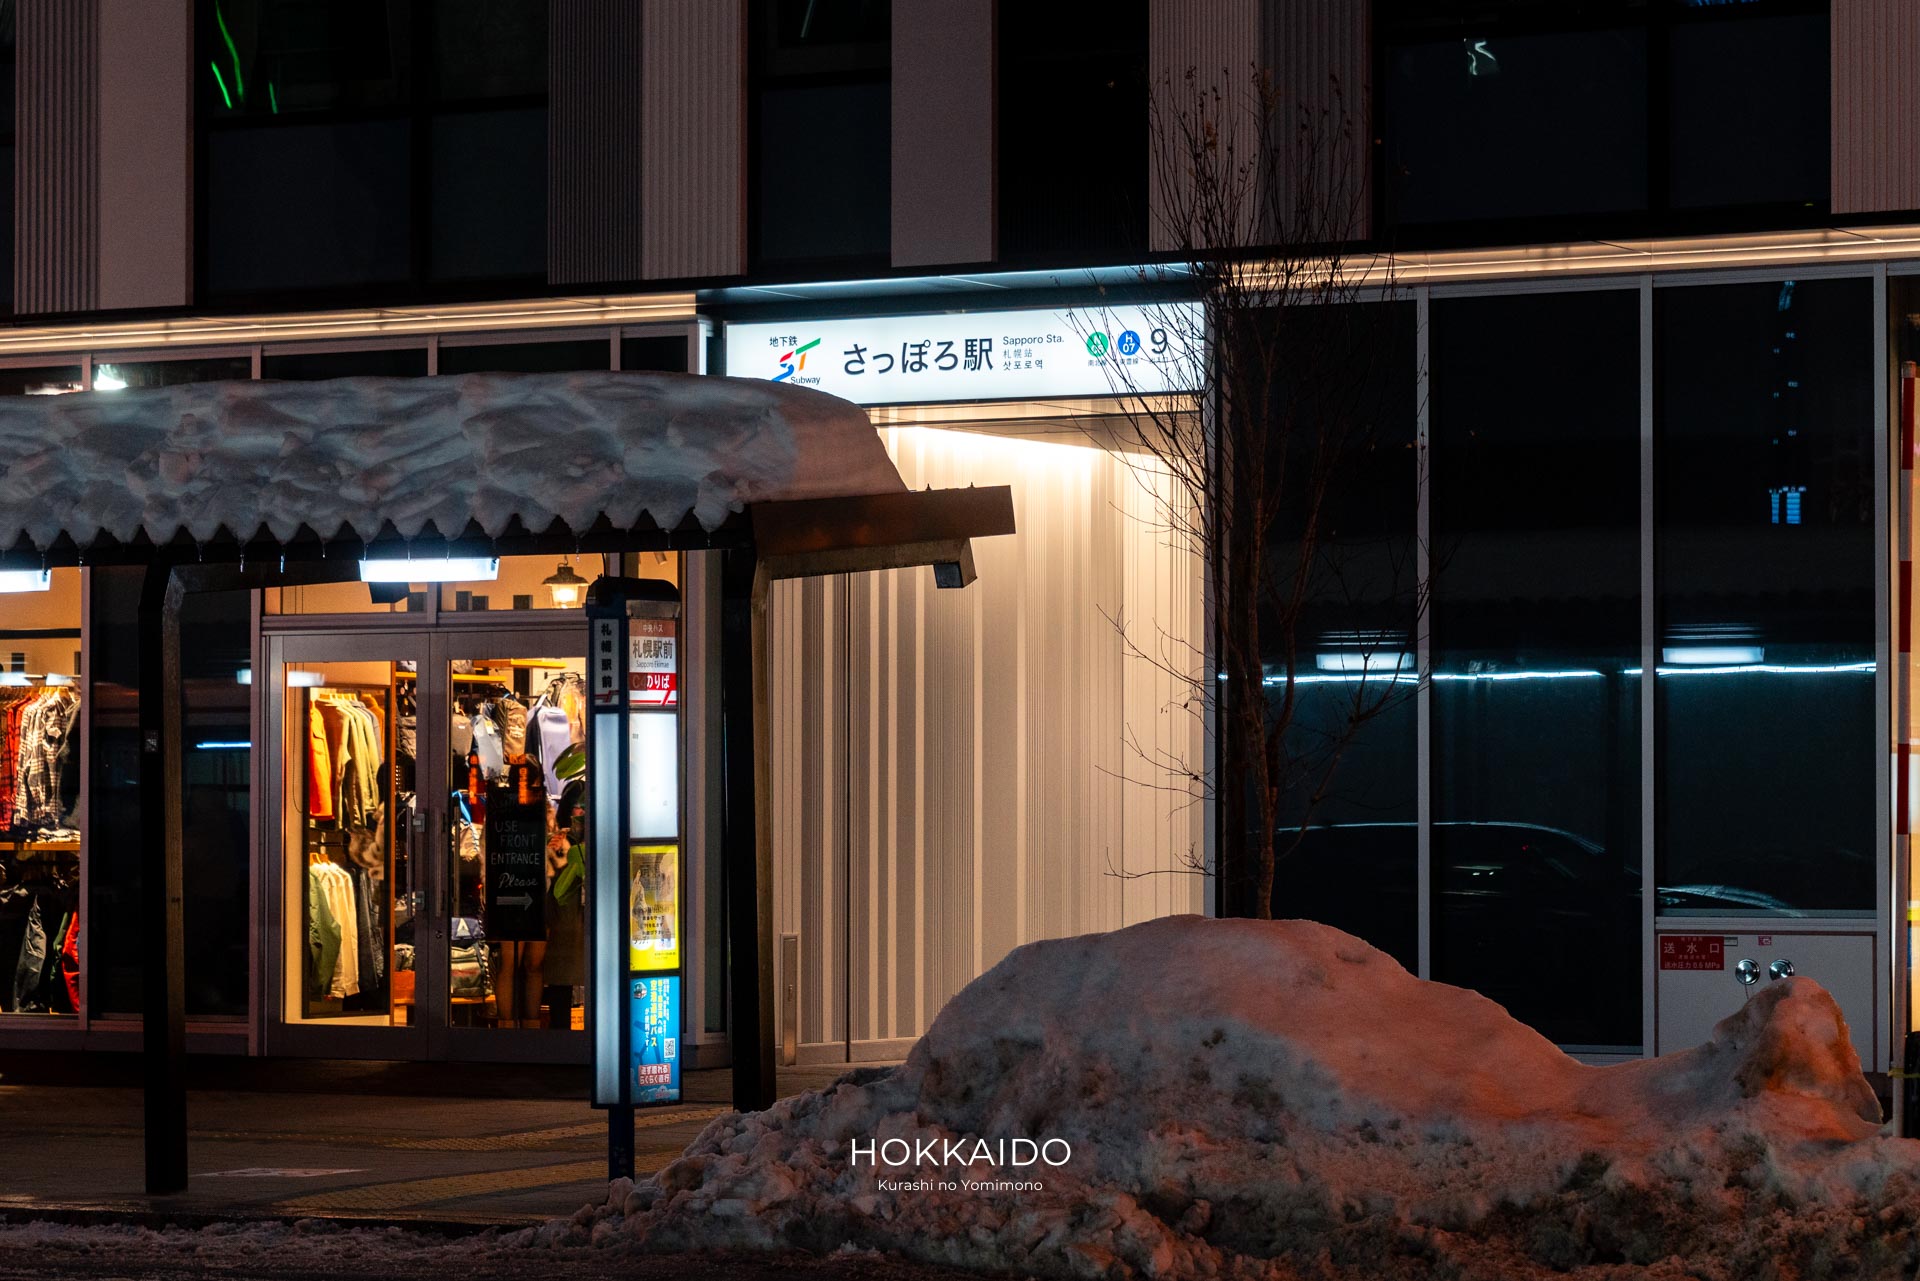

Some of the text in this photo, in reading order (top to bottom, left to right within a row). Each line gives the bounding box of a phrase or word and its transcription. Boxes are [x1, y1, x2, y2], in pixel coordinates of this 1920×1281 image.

[769, 336, 798, 347] 地下鉄
[1003, 333, 1065, 346] Sapporo Sta.
[1125, 334, 1133, 343] H
[1150, 328, 1167, 354] 9
[1122, 344, 1135, 353] 07
[843, 338, 993, 375] さっぽろ駅
[1003, 359, 1043, 371] 삿포로역
[790, 376, 821, 385] Subway
[601, 623, 612, 689] 札幌駅前
[632, 639, 673, 660] 札幌駅前
[495, 820, 518, 832] USE
[500, 833, 537, 848] FRONT
[490, 852, 540, 865] ENTRANCE
[498, 872, 538, 889] Please
[1664, 942, 1720, 954] 送水口
